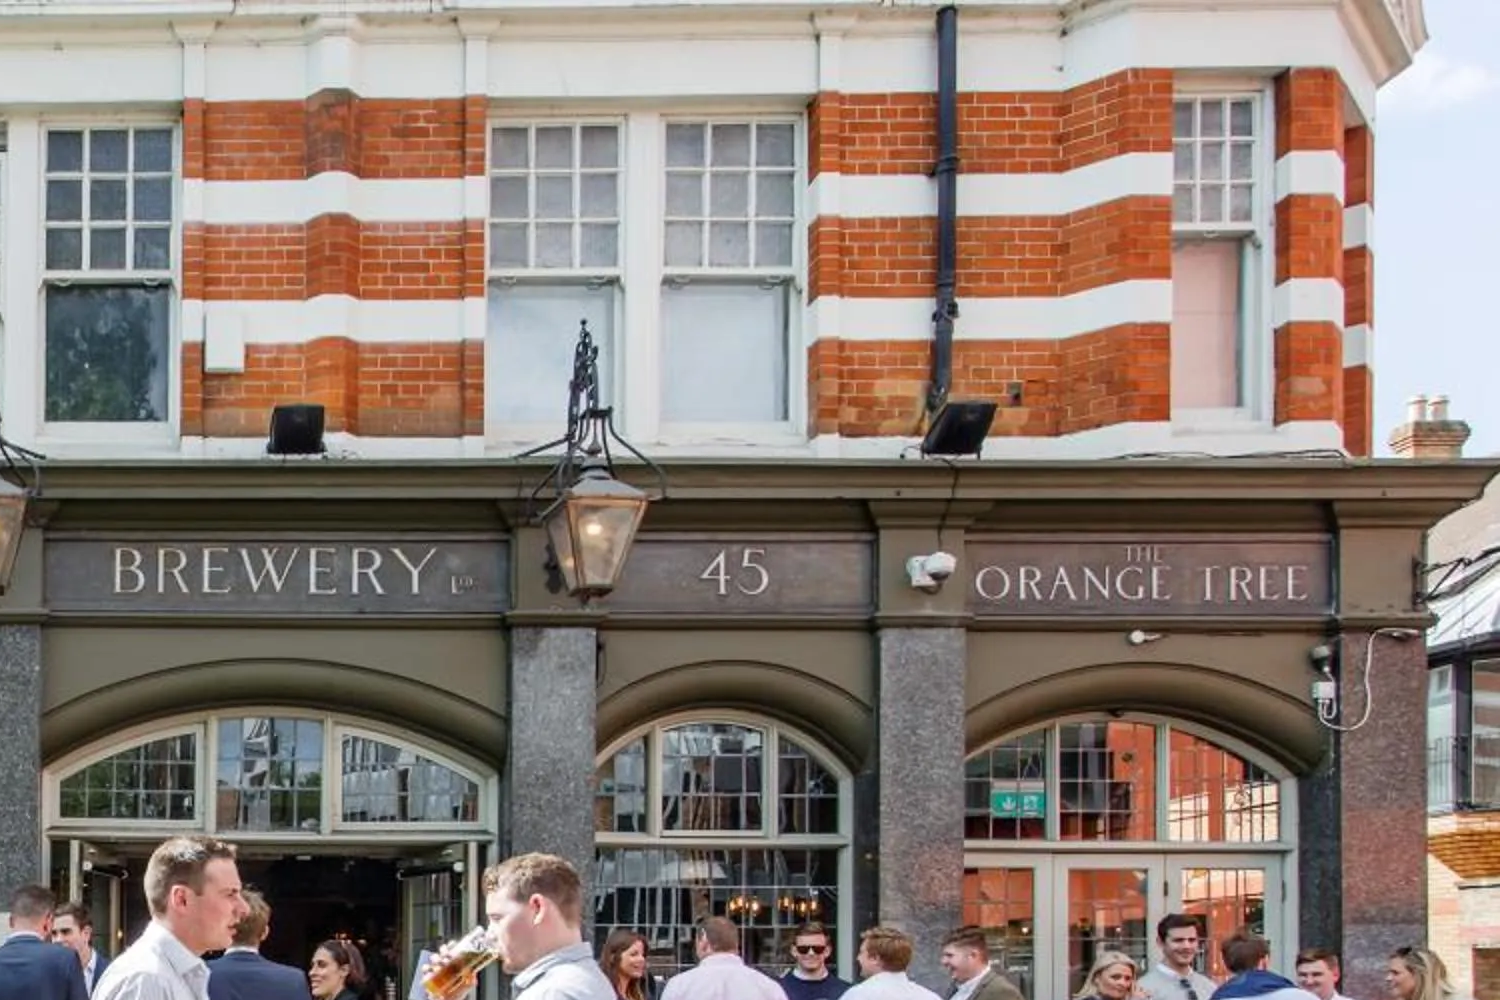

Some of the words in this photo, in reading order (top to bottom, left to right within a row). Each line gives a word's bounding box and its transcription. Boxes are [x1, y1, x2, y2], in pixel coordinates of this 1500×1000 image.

[113, 547, 438, 595] BREWERY
[700, 547, 770, 596] 45
[1124, 545, 1164, 563] THE
[974, 565, 1173, 601] ORANGE
[1200, 566, 1309, 601] TREE
